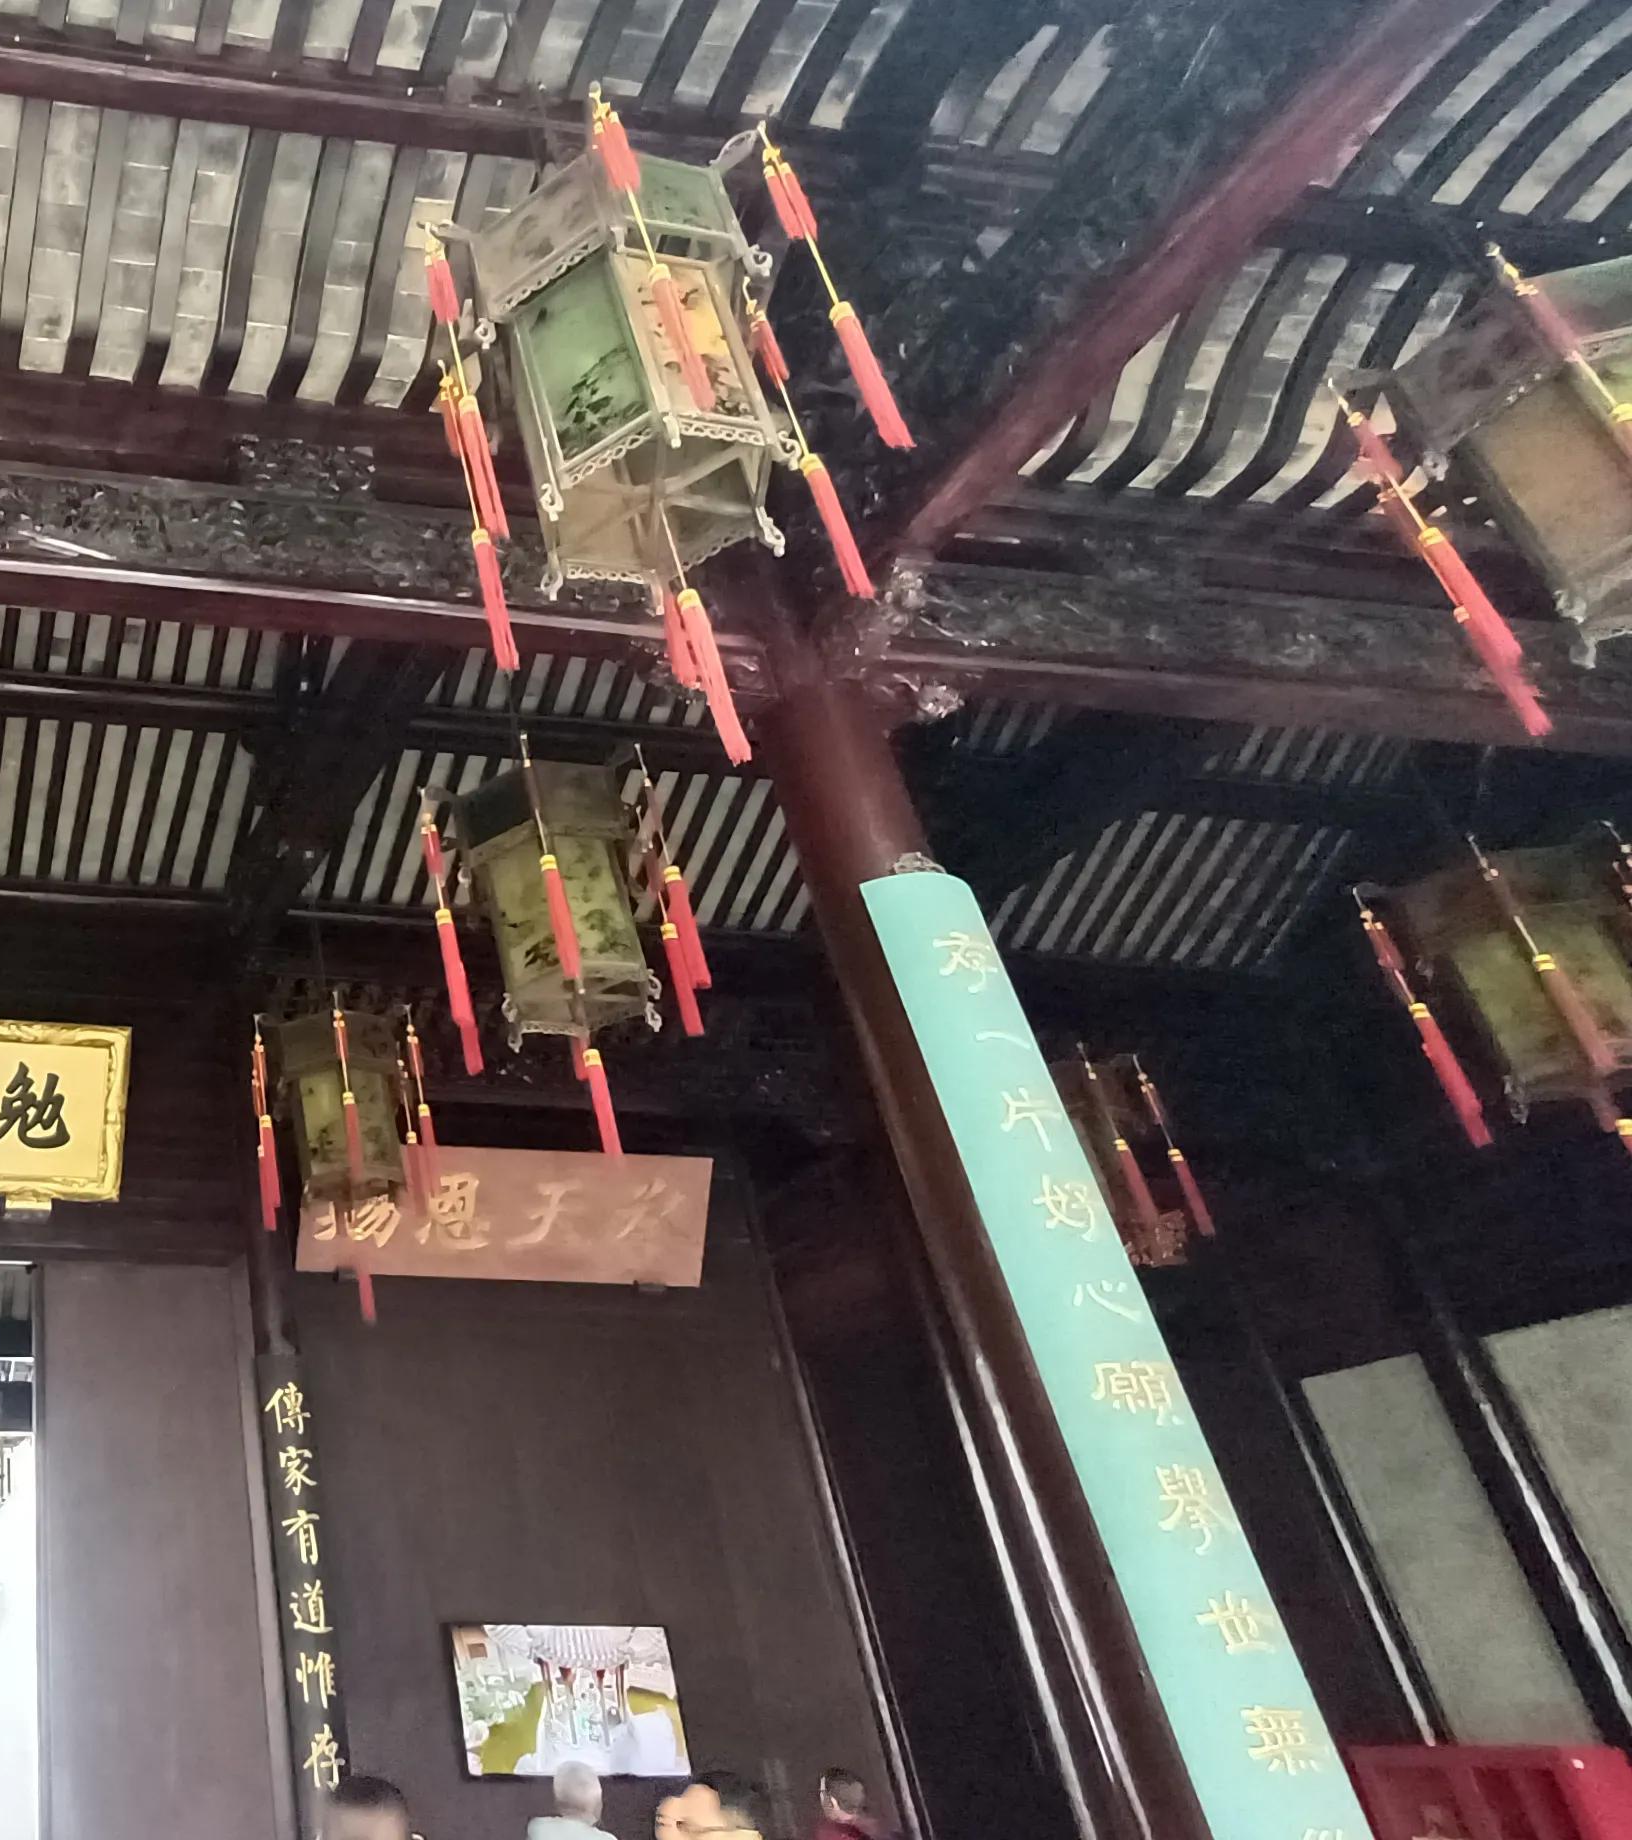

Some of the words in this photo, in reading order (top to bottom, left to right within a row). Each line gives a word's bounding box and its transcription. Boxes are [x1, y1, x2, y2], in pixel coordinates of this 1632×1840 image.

[932, 930, 1345, 1840] 存一片好心願舉世無
